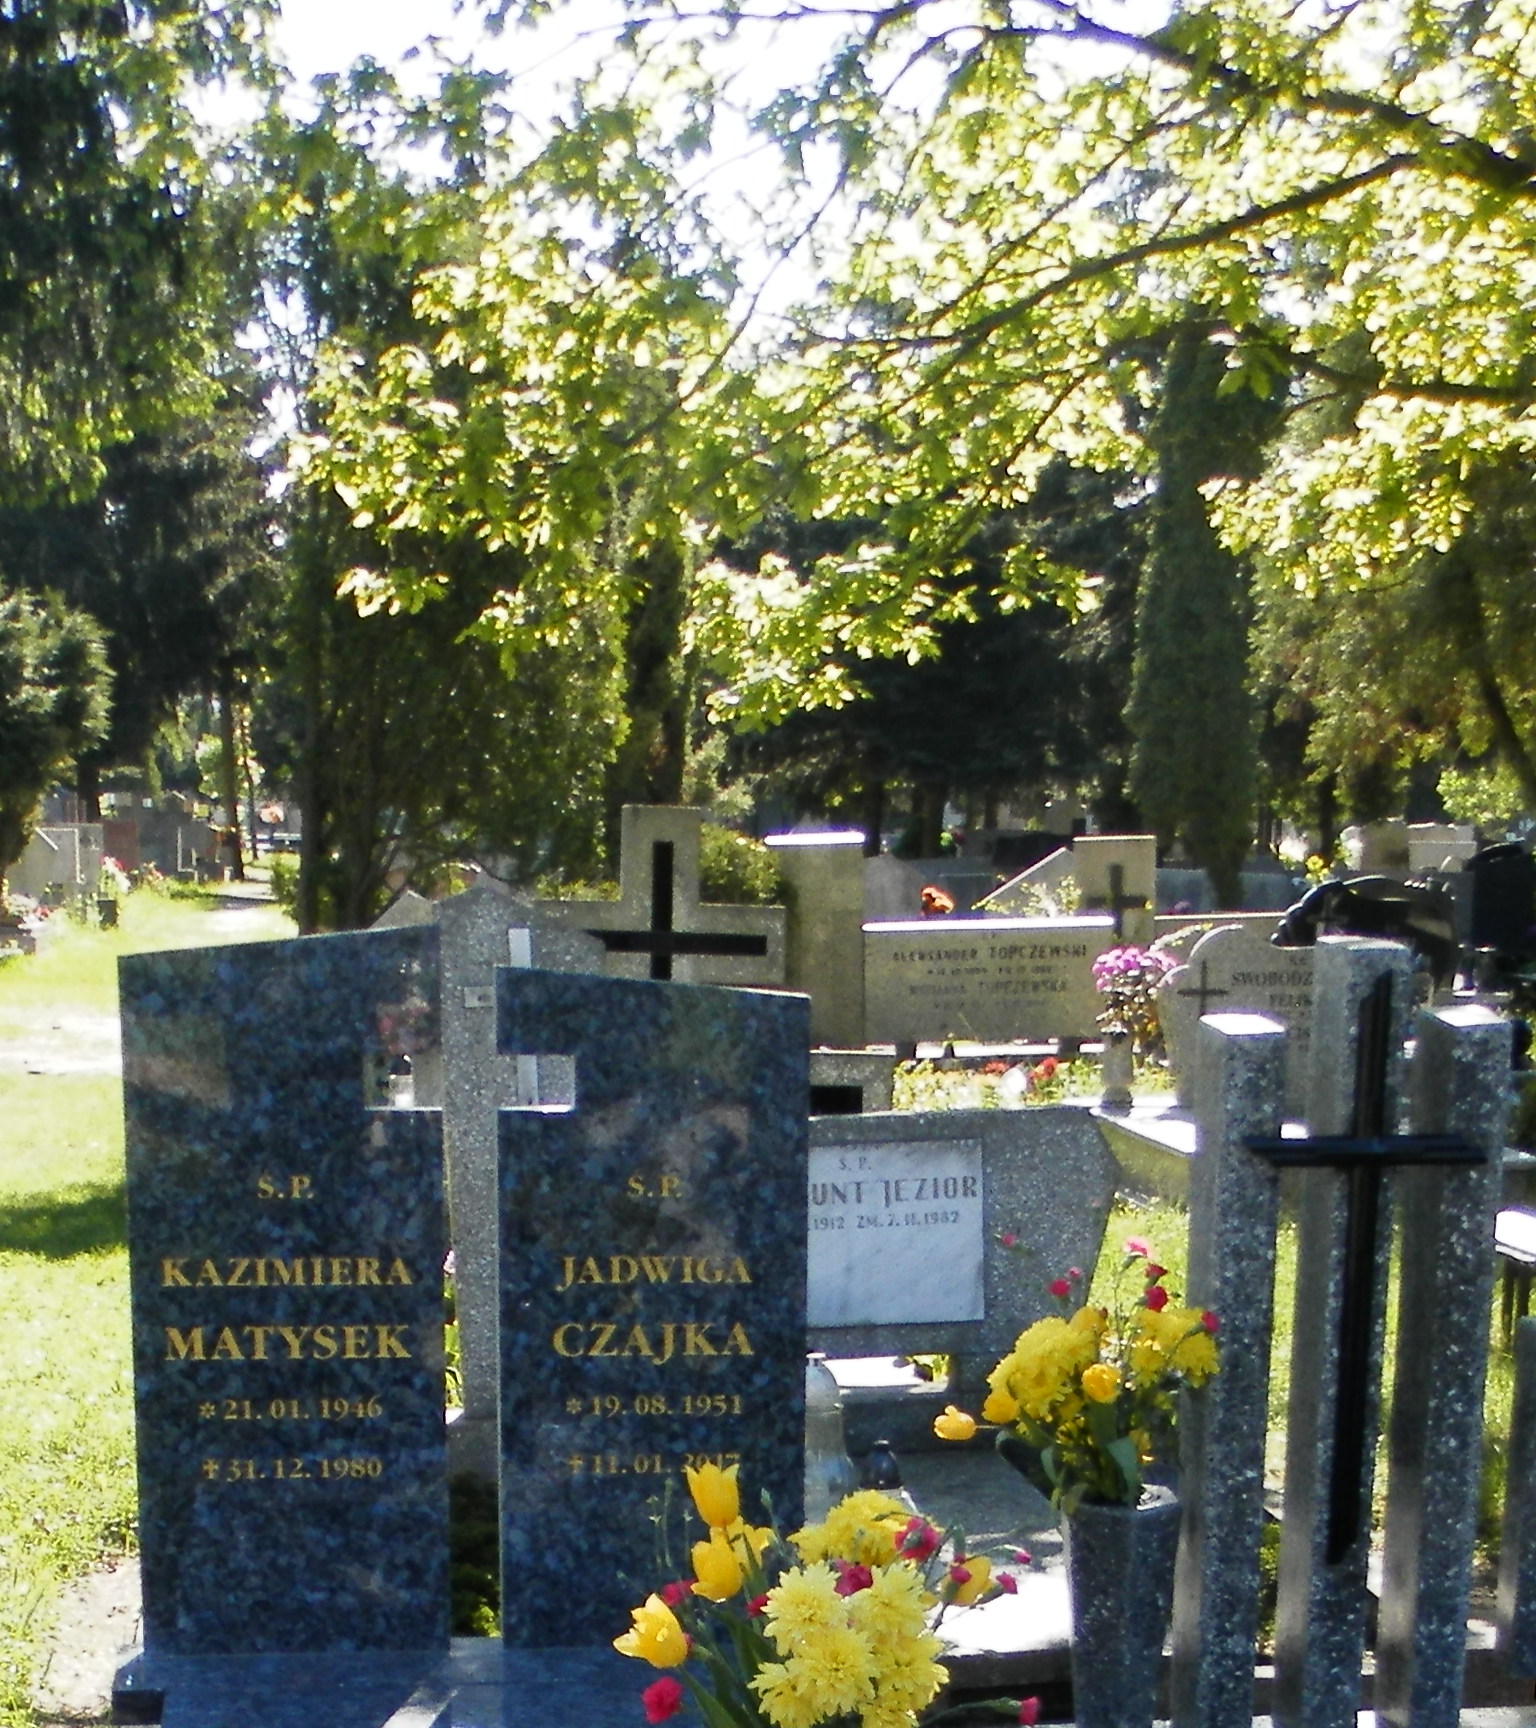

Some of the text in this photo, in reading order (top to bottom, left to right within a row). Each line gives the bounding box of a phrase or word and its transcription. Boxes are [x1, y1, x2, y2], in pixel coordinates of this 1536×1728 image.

[811, 1175, 978, 1209] UNT JEZIOR
[161, 1256, 413, 1288] KAZIMIERA
[554, 1255, 753, 1292] JADWIGA
[164, 1324, 413, 1361] MATYSEK
[552, 1321, 755, 1365] CZAJKA
